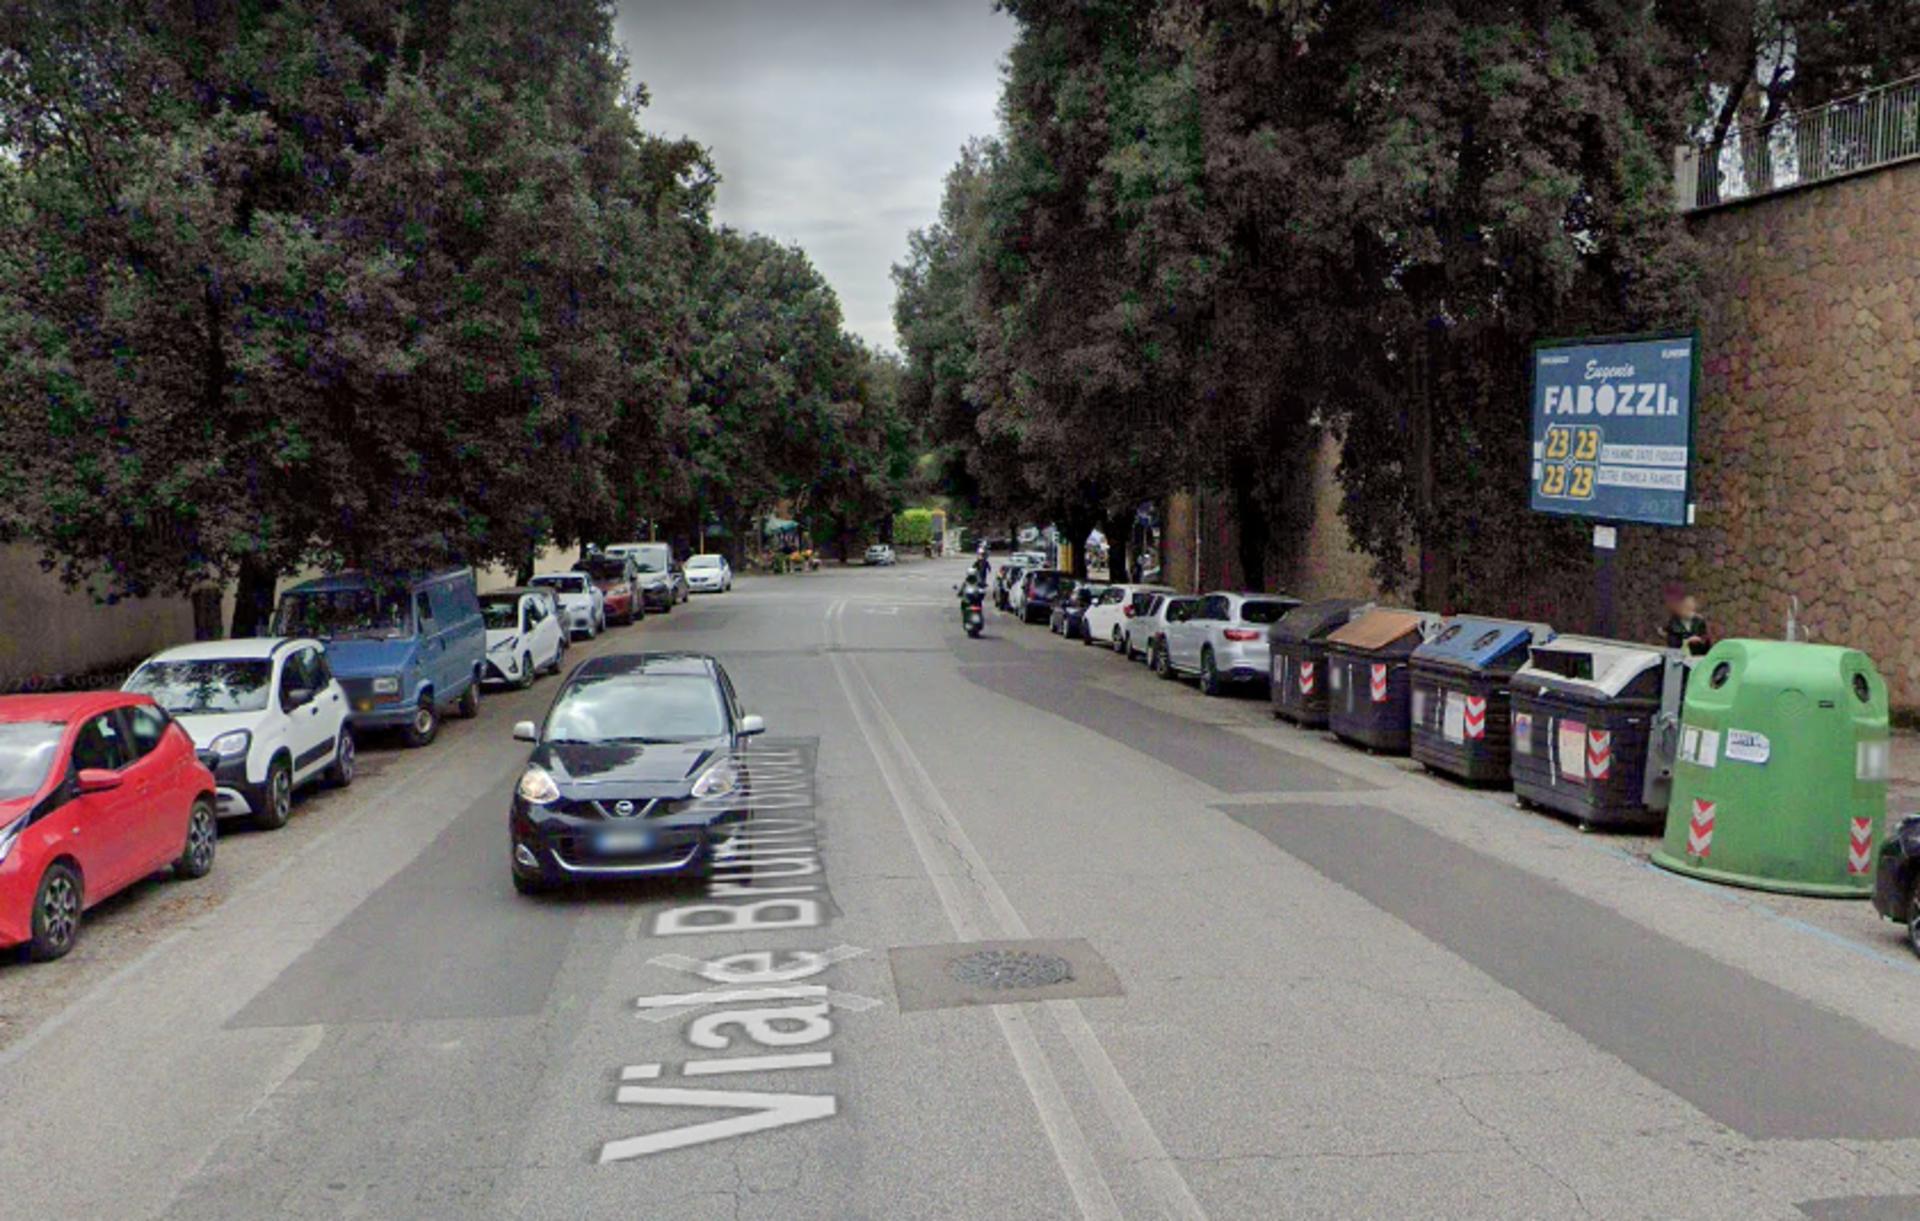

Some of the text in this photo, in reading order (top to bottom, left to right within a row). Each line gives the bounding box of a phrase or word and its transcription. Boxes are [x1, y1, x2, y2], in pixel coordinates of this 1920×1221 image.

[1584, 359, 1635, 384] Eugenio
[1543, 383, 1667, 416] FABOZZI
[1547, 429, 1569, 459] 23
[1575, 430, 1599, 460] 23
[1542, 465, 1565, 494] 23
[1570, 466, 1594, 496] 23
